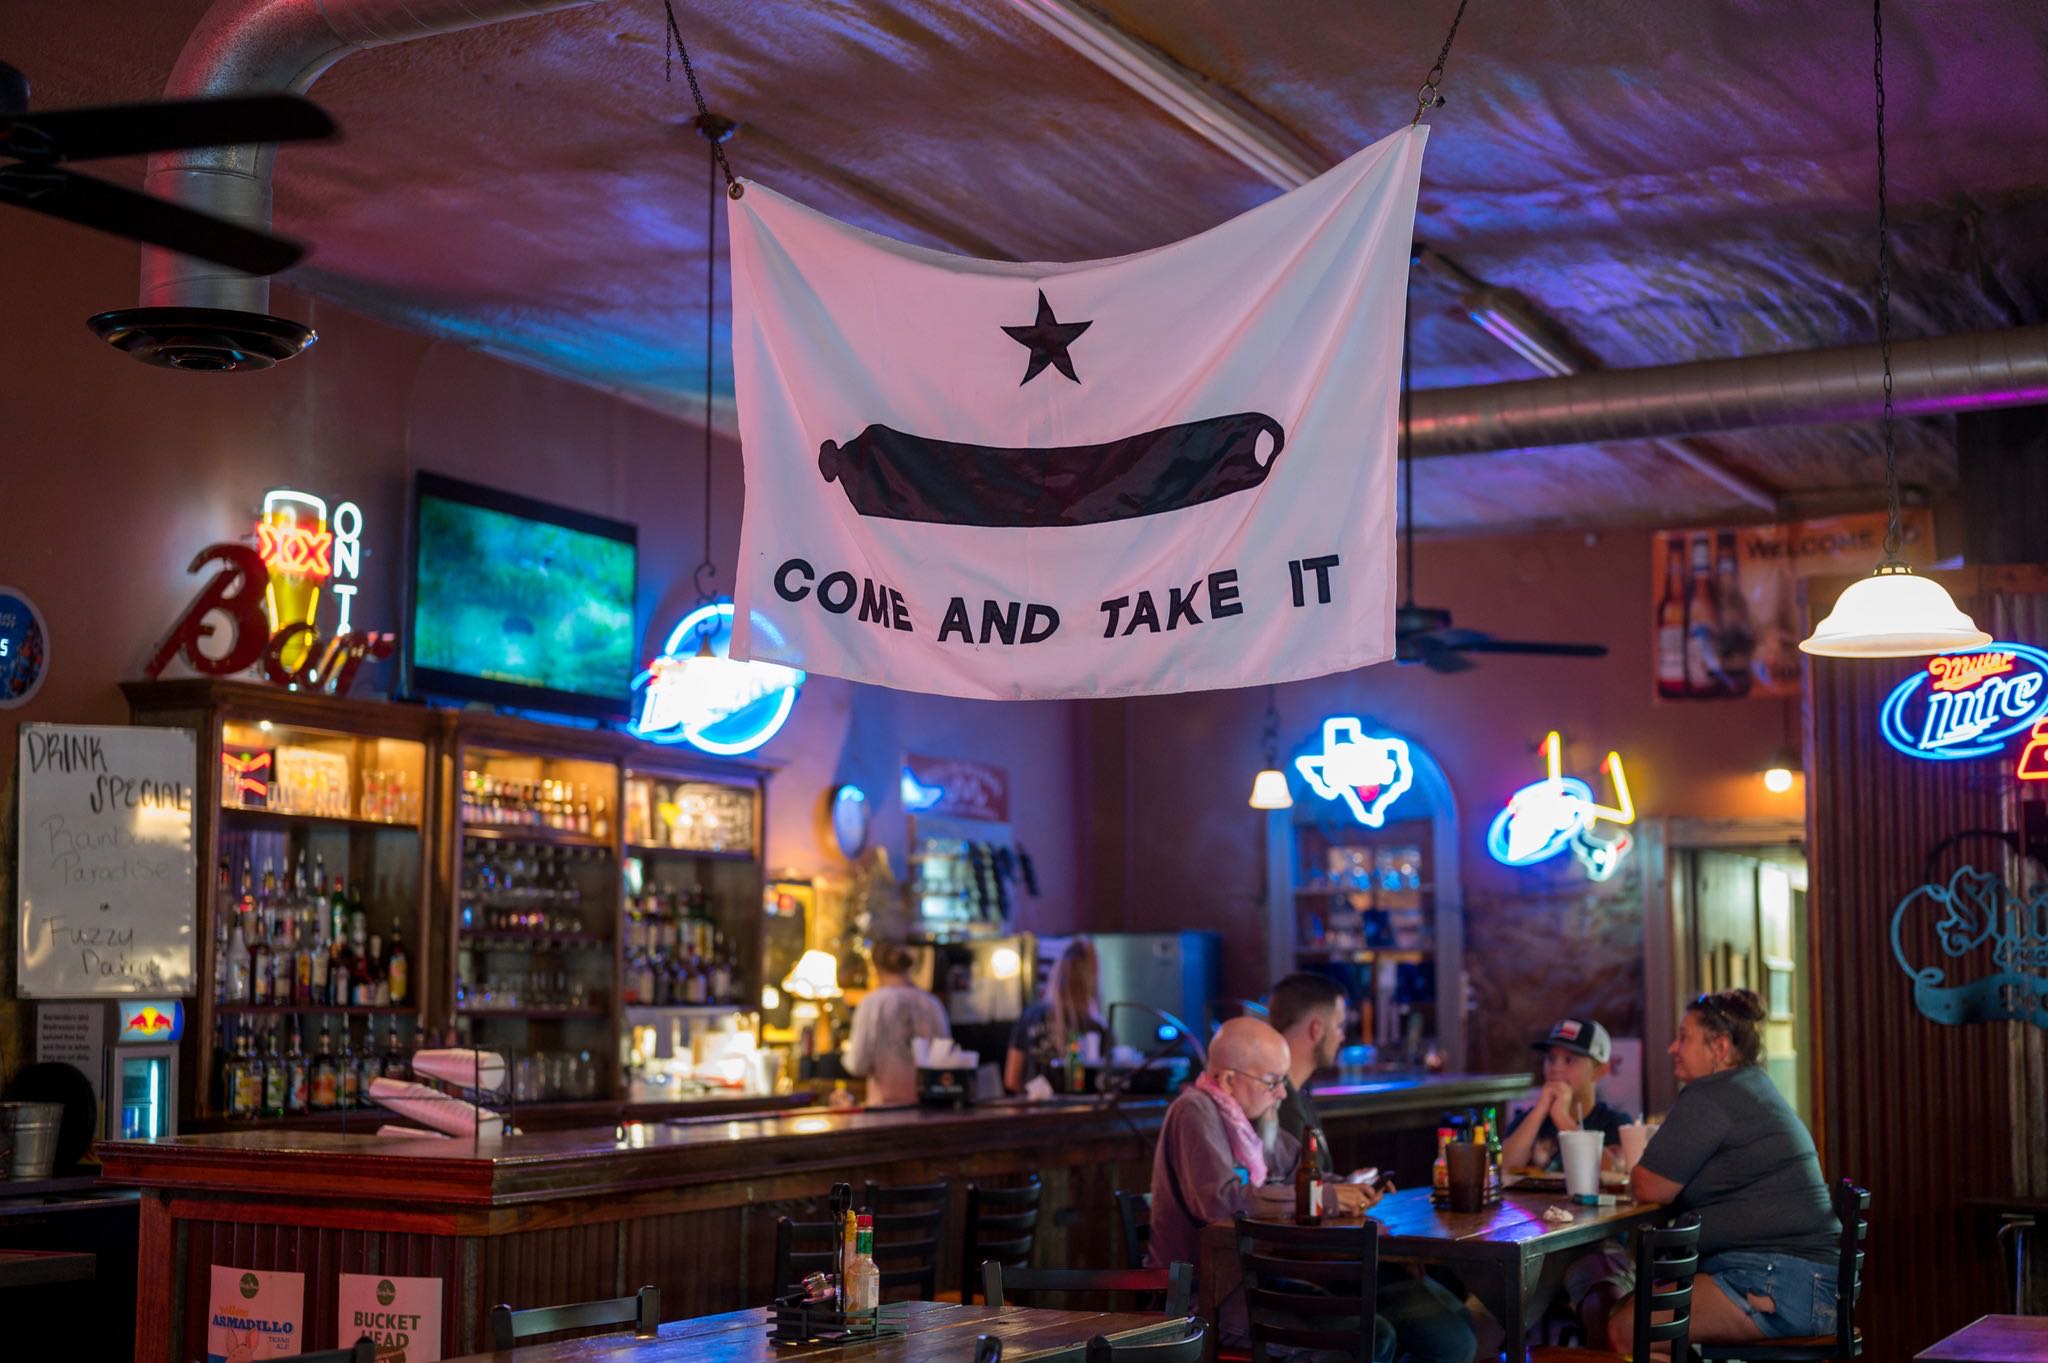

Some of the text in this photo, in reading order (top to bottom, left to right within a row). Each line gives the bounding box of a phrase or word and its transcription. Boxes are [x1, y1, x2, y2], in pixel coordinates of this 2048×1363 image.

[145, 541, 396, 694] Bar
[774, 554, 1340, 645] COME AND TAKE IT
[27, 731, 108, 774] DRINK
[42, 914, 134, 950] Fuzzy
[212, 1314, 293, 1333] ARMADILLO
[354, 1311, 421, 1330] BUCKET
